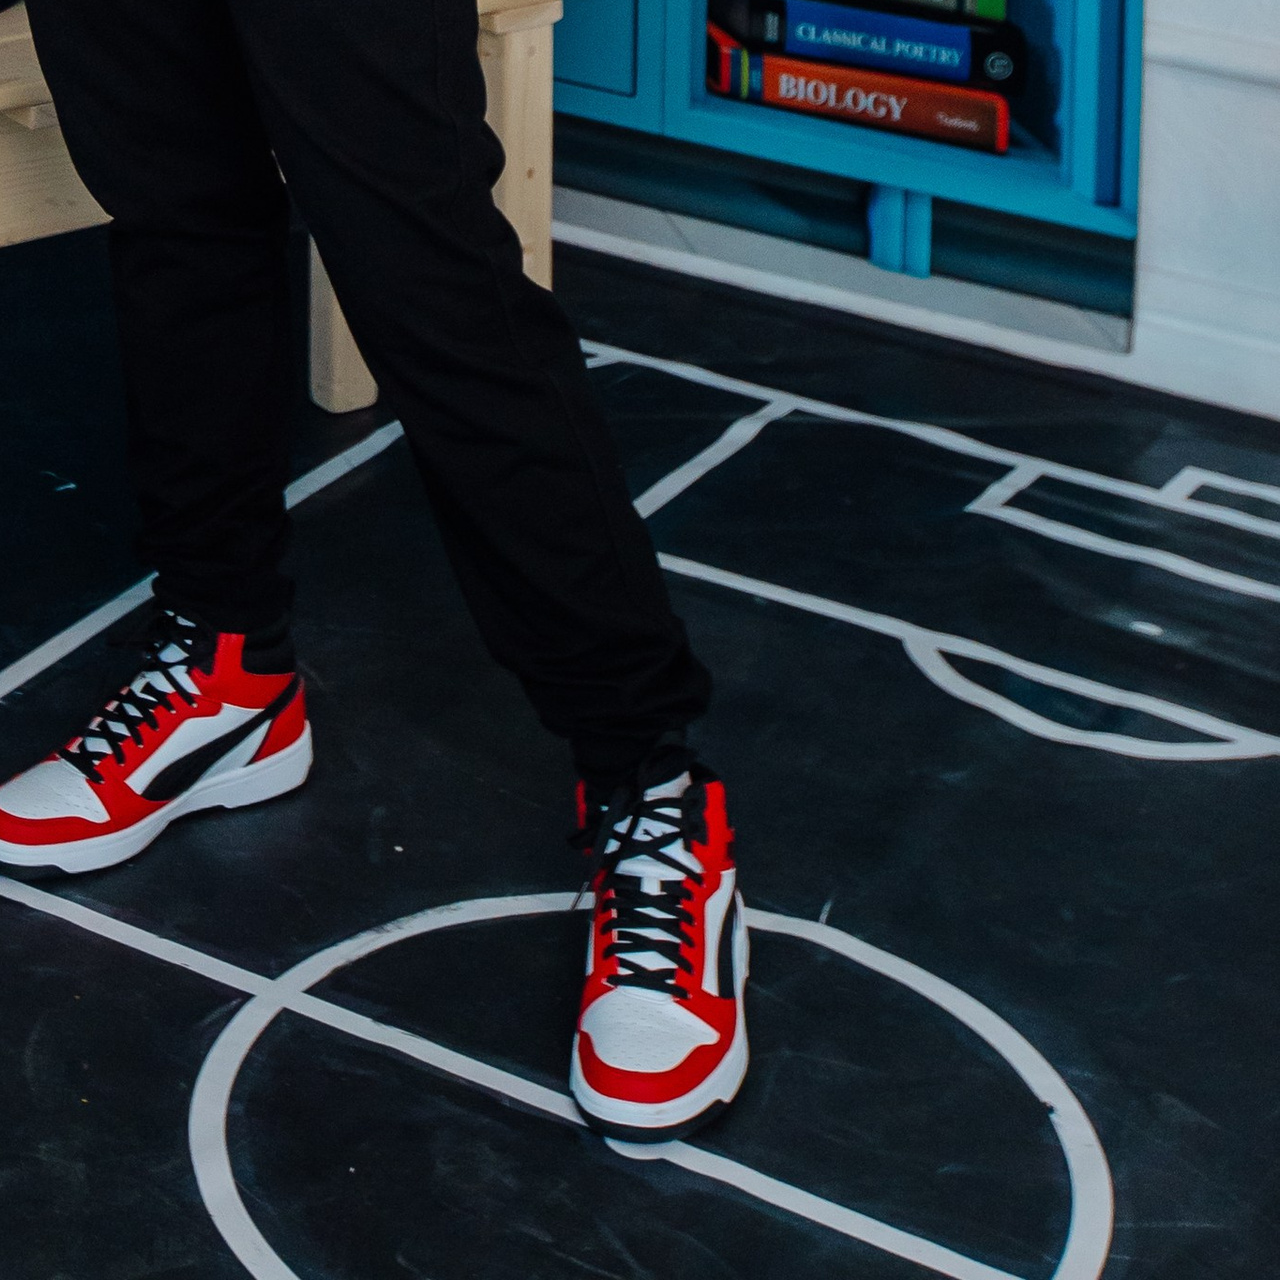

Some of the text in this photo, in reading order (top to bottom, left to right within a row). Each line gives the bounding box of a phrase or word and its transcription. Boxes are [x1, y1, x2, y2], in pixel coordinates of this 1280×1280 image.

[795, 22, 887, 54] CLASSICAL
[893, 39, 964, 68] POETRY
[778, 73, 910, 122] BIOLOGY
